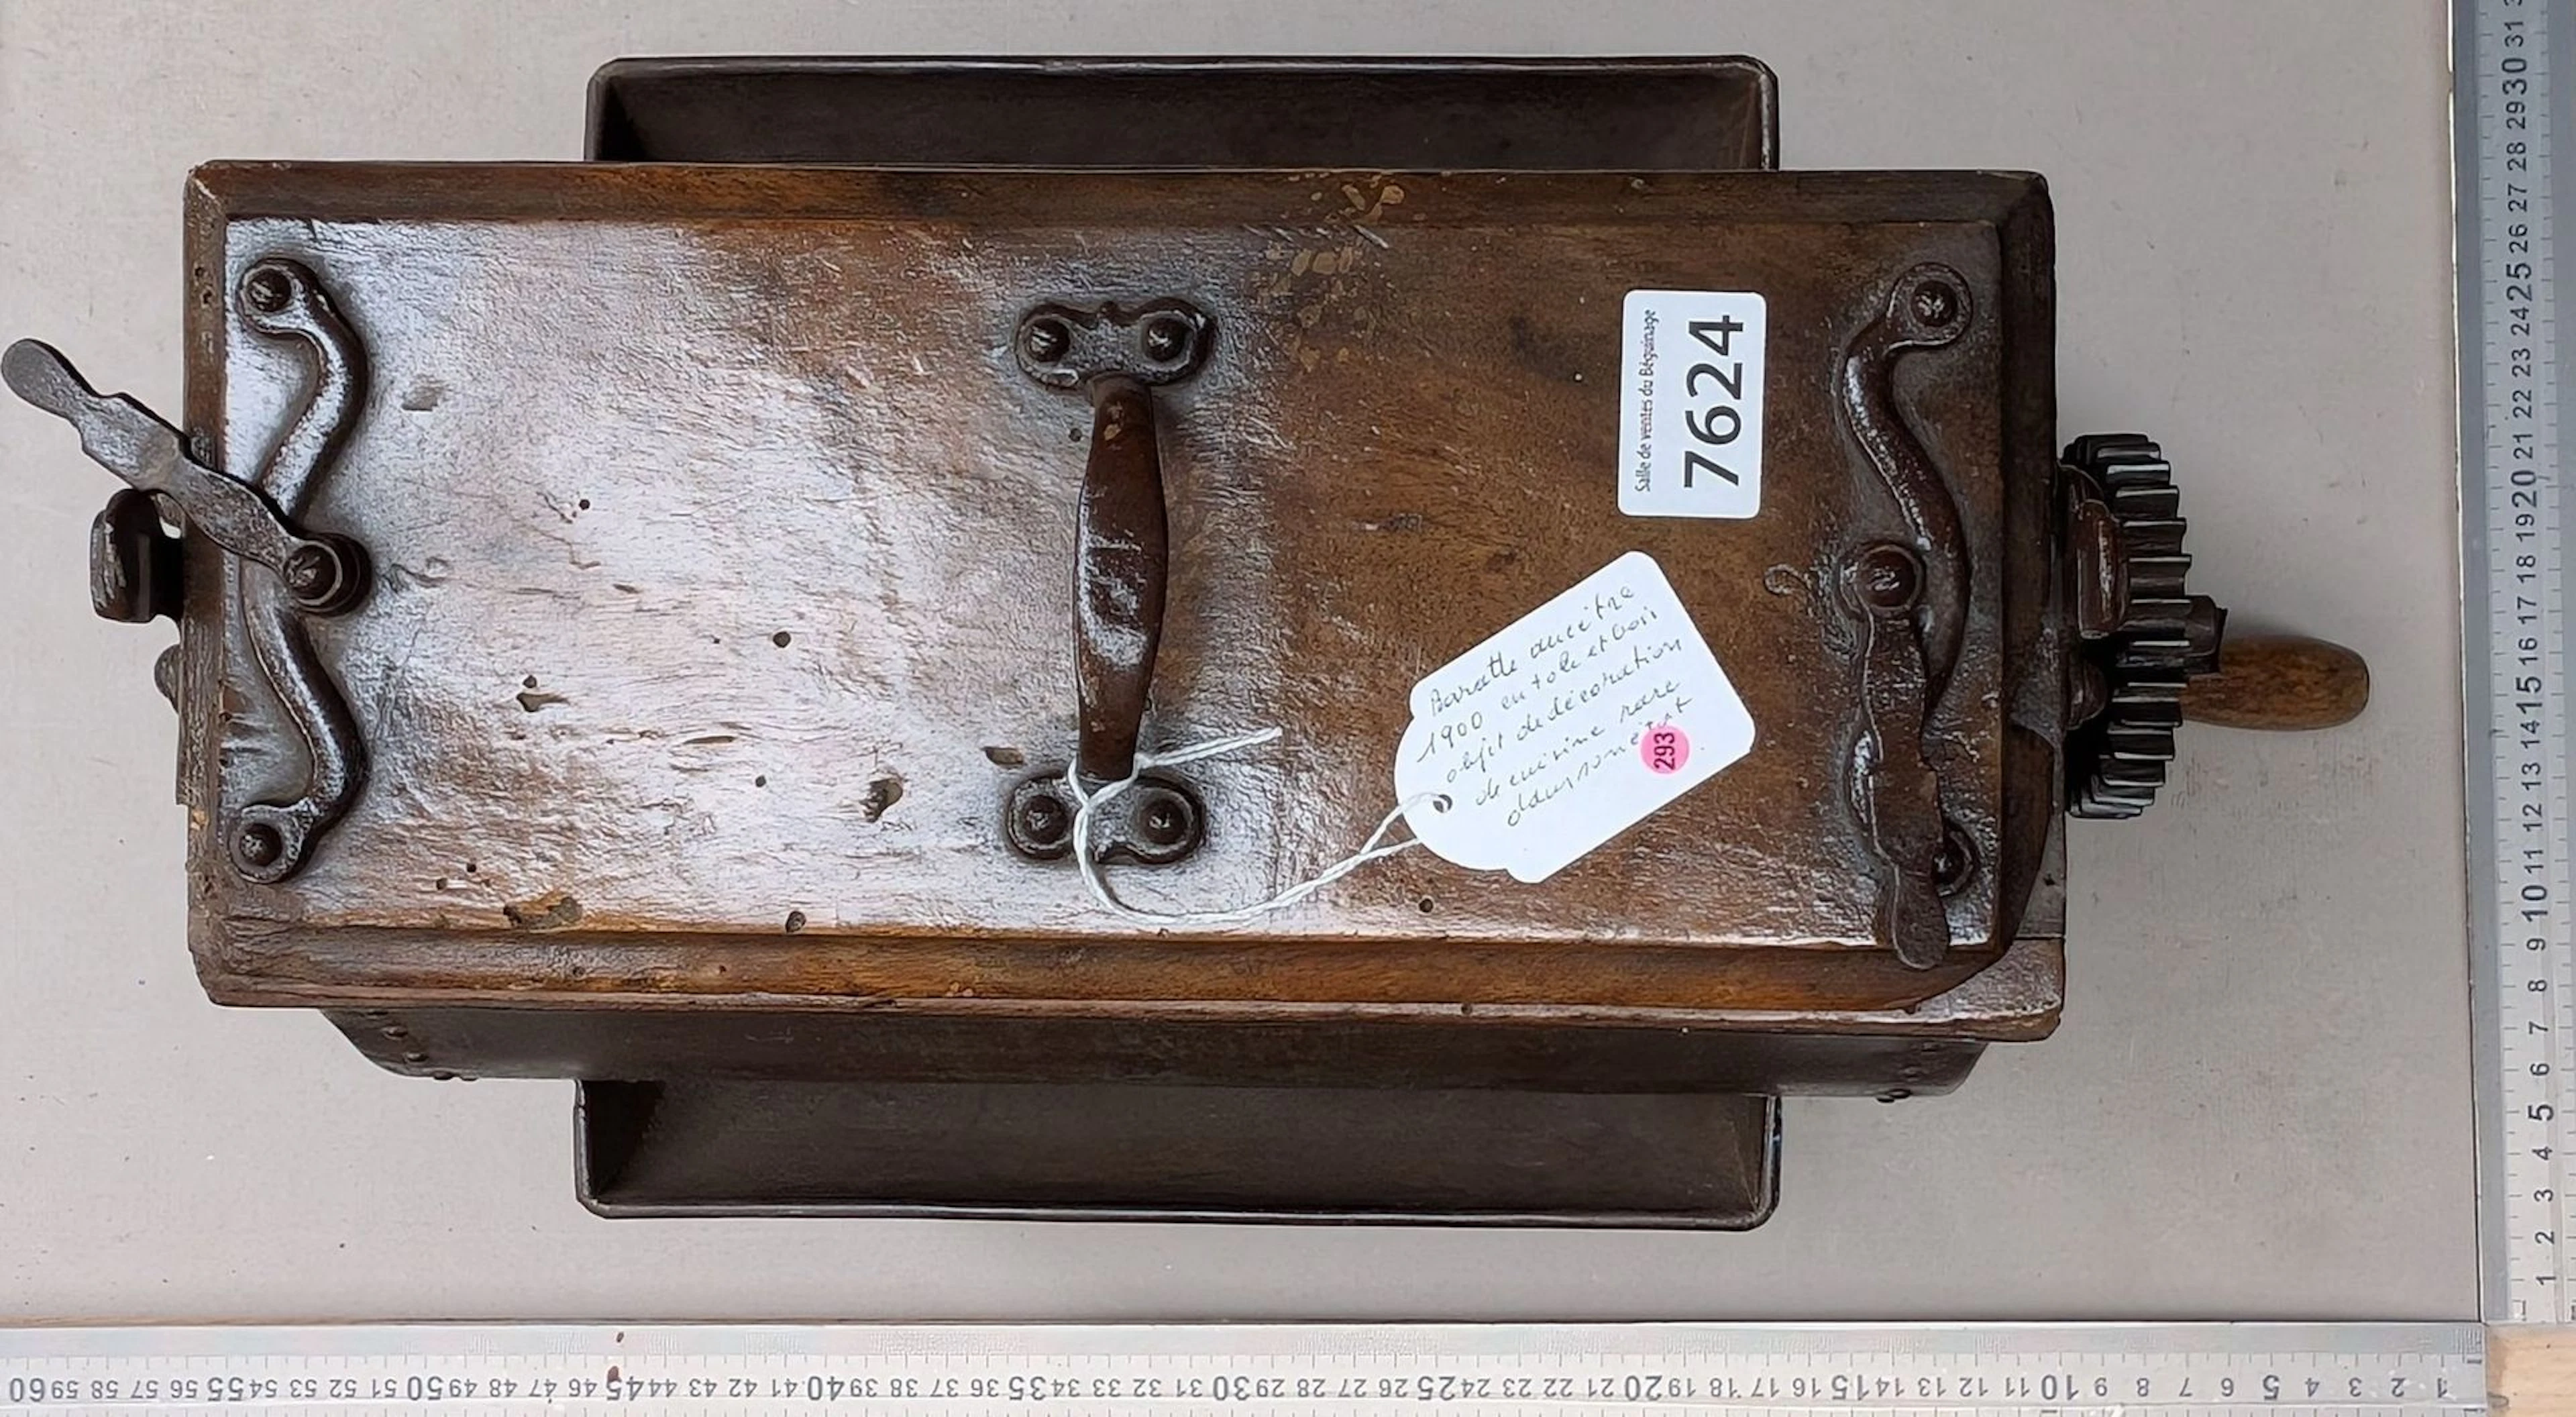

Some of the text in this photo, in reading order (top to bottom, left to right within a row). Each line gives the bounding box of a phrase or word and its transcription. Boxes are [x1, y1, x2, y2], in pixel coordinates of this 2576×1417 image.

[2504, 21, 2524, 47] 31
[2502, 58, 2527, 95] 30
[2506, 101, 2525, 129] 29
[2506, 142, 2526, 172] 28
[2508, 183, 2527, 213] 27
[2508, 224, 2528, 254] 26
[2506, 263, 2532, 301] 25
[2510, 307, 2530, 336] 24
[2512, 348, 2531, 378] 23
[1635, 309, 1659, 492] Salle de ventes du Béguinage
[1684, 315, 1743, 488] 7624
[2512, 390, 2532, 419] 22
[2512, 434, 2533, 459] 21
[2511, 470, 2537, 508] 20
[2515, 514, 2535, 542] 19
[2516, 555, 2536, 584] 18
[2517, 596, 2537, 625] 17
[2518, 637, 2538, 666] 16
[2516, 676, 2542, 715] 15
[1417, 711, 1483, 763] 1900
[2520, 721, 2540, 749] 14
[1653, 732, 1676, 771] 293
[2521, 762, 2542, 791] 13
[2522, 803, 2542, 832] 12
[2523, 849, 2544, 874] 11
[2521, 885, 2548, 923] 10
[2526, 938, 2546, 951] 9
[2528, 980, 2548, 992] 8
[2528, 1021, 2548, 1035] 7
[2530, 1063, 2550, 1076] 6
[2528, 1104, 2555, 1121] 5
[2532, 1146, 2553, 1161] 4
[2534, 1189, 2554, 1202] 3
[2534, 1231, 2555, 1245] 2
[2536, 1275, 2557, 1285] 1
[9, 1374, 2447, 1402] 1 2 3 4 5 6 7 8 9 10 11 12 13 14 15 16 17 18 19 20 21 22 23 24 25 26 27 28 29 30 31 32 33 34 35 36 37 38 39 40 41 42 43 44 45 46 47 48 49 50 51 52 53 54 55 56 57 58 59 60
